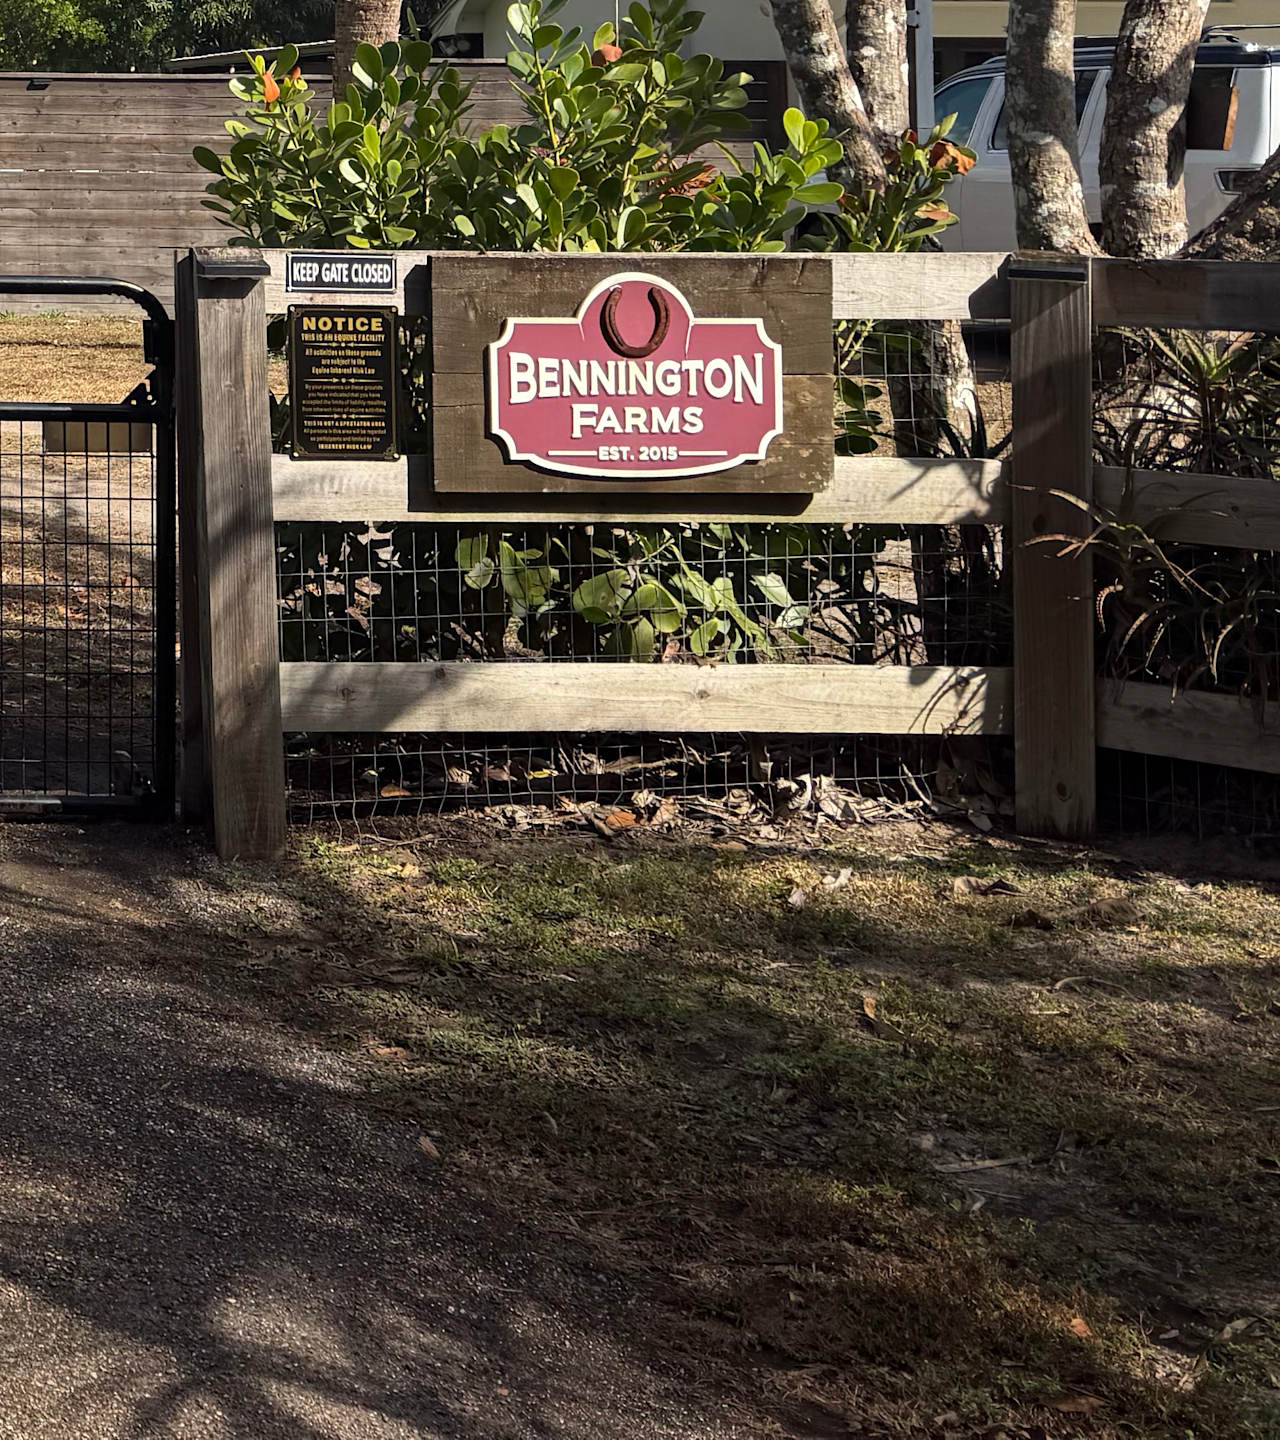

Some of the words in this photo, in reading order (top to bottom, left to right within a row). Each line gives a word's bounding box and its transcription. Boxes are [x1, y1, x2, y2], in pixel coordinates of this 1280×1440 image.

[293, 262, 319, 282] KEEP
[321, 263, 349, 282] GATE
[351, 263, 391, 283] CLOSED
[302, 317, 383, 331] NOTICE
[301, 333, 315, 341] THIS
[316, 333, 323, 341] IS
[358, 333, 385, 341] FACILITY
[508, 351, 764, 404] BENNINGTON
[571, 403, 704, 438] FARMS
[598, 446, 634, 460] EST.
[639, 446, 678, 460] 2015
